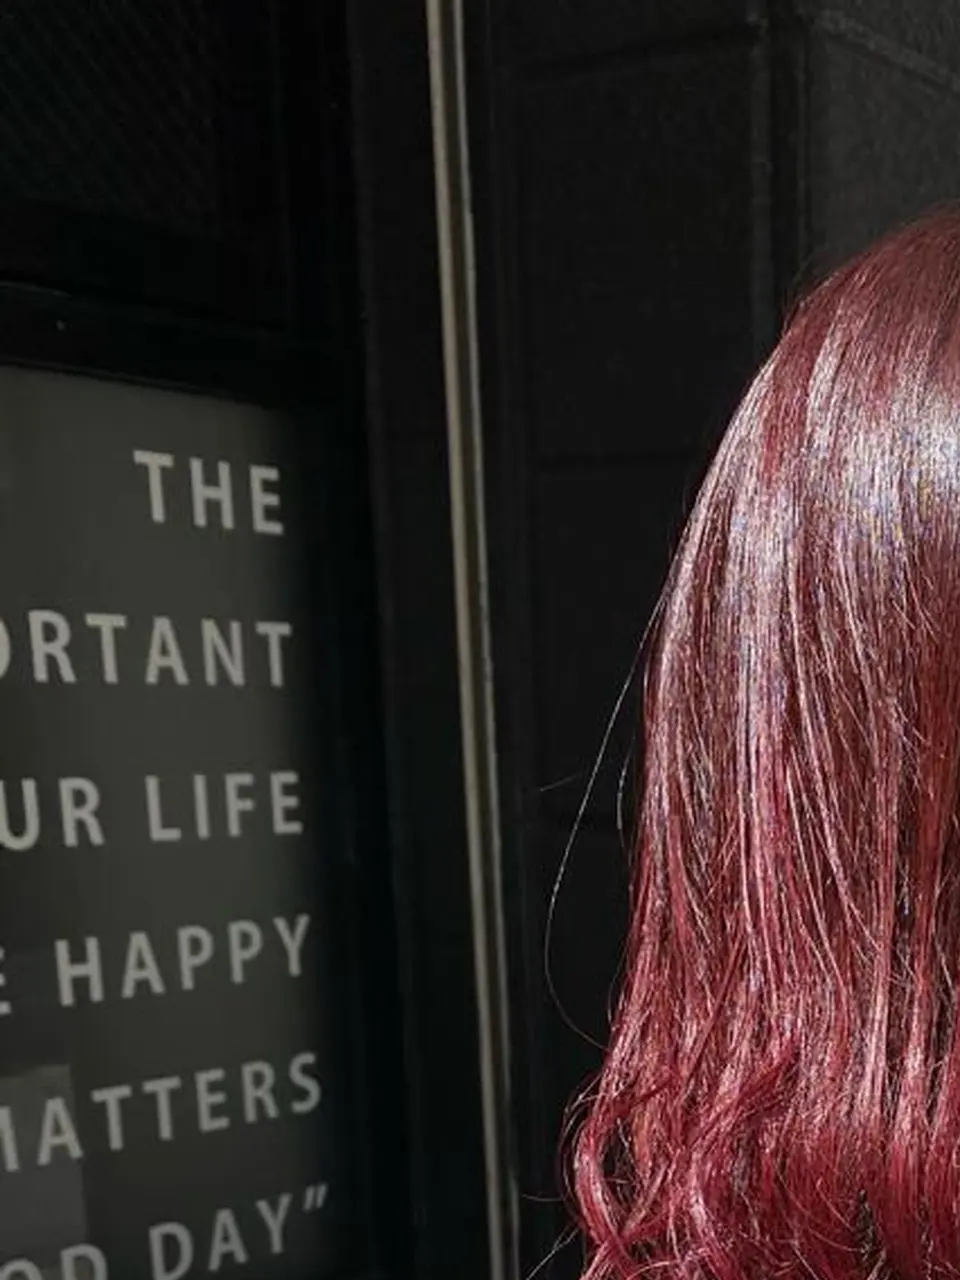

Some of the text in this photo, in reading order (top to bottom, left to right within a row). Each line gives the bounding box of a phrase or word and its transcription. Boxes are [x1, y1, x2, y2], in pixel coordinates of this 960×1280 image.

[133, 449, 284, 535] THE
[0, 609, 292, 688] RTANT
[145, 770, 303, 842] LIFE
[55, 913, 310, 1007] HAPPY
